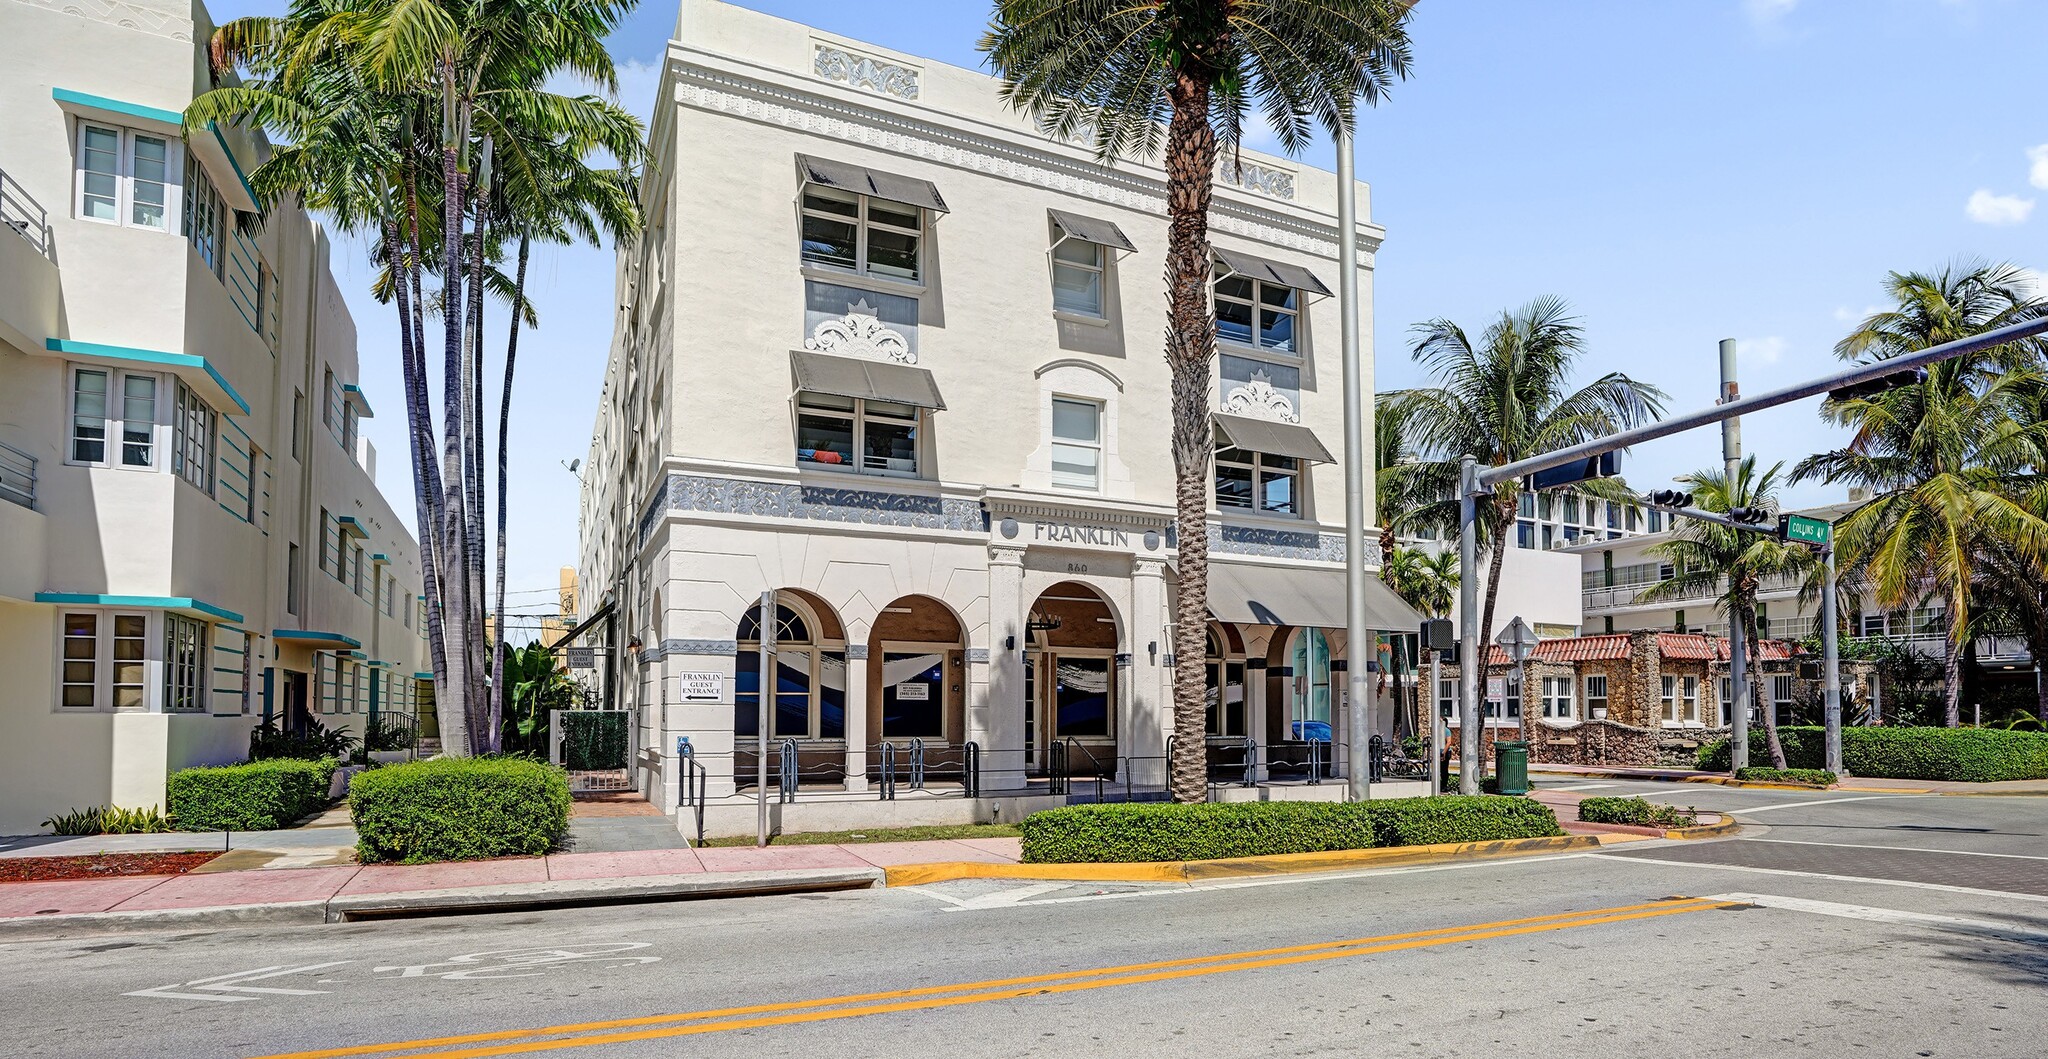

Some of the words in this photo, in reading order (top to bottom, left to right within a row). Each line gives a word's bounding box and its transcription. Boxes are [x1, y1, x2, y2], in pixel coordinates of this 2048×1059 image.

[1035, 521, 1128, 547] FRANKLIN
[1792, 522, 1814, 535] COLLINS
[1067, 563, 1088, 574] 860
